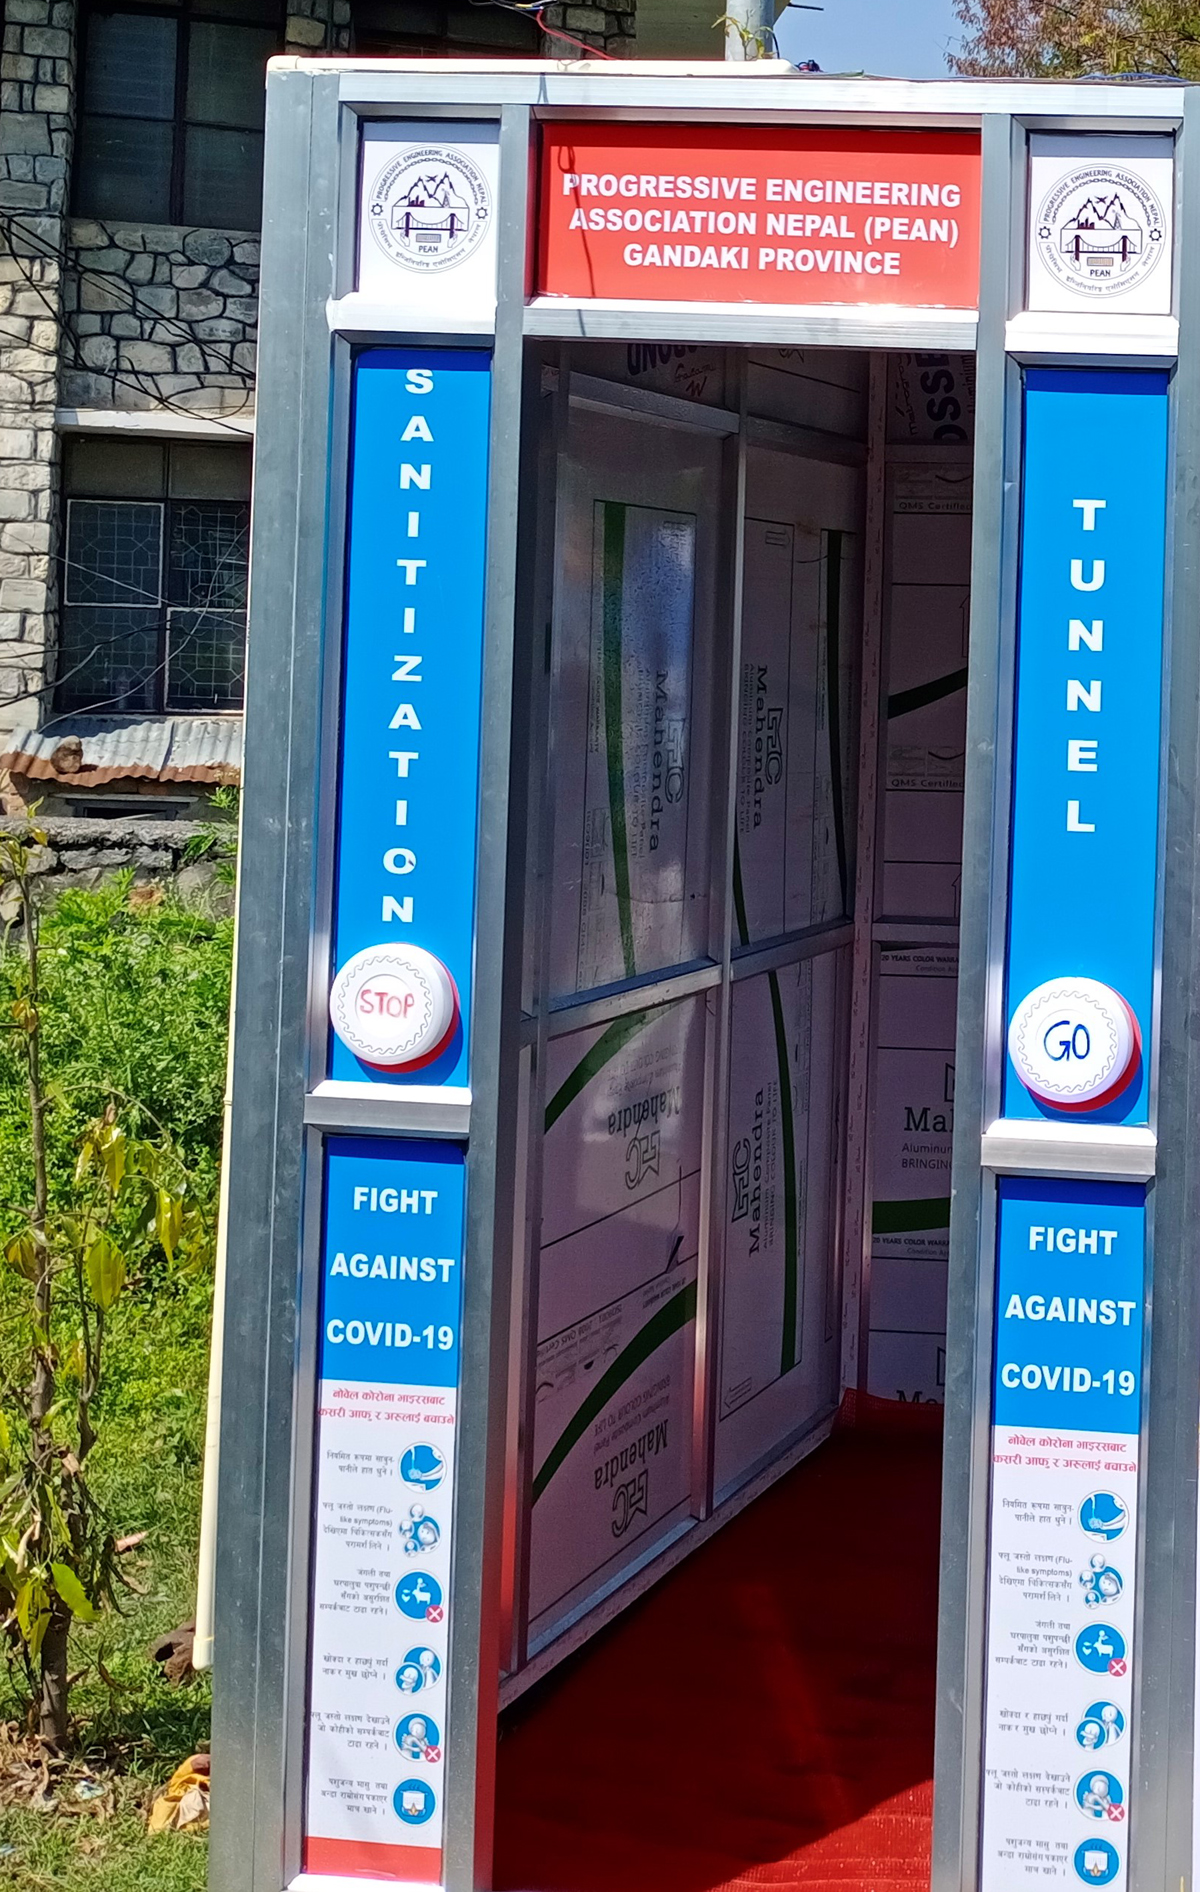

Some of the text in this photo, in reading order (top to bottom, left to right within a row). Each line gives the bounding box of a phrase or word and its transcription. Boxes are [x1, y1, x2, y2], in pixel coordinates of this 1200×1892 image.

[376, 161, 402, 199] PROGRESSIVE
[403, 150, 442, 162] ENGINEERING
[445, 153, 478, 181] ASSOCIATION
[563, 173, 961, 208] PROGRESSIVE ENGINEERING
[1043, 170, 1160, 225] PROGRESSIVE ENGINEERING ASSOCIATION NEPAL
[569, 208, 959, 248] ASSOCIATION NEPAL (PEAN)
[623, 243, 900, 275] GANDAKI PROVINCE
[1090, 269, 1111, 277] PEAN
[381, 368, 435, 922] SANITIZATION
[1066, 498, 1107, 833] TUNNEL
[649, 669, 668, 852] Mahendra
[753, 665, 768, 829] Mahendra
[359, 989, 415, 1020] STOP
[1043, 1020, 1091, 1063] GO
[749, 1088, 764, 1257] Mahendra
[353, 1186, 438, 1215] FIGHT
[1029, 1226, 1118, 1255] FIGHT
[330, 1252, 455, 1283] AGAINST
[1004, 1294, 1137, 1326] AGAINST
[327, 1319, 454, 1351] COVID-19
[362, 1390, 394, 1402] कोरोना
[1001, 1363, 1135, 1396] COVID-19
[594, 1418, 669, 1490] Mahendra
[1039, 1436, 1073, 1449] कोरोना
[1016, 1566, 1073, 1578] like symptoms)
